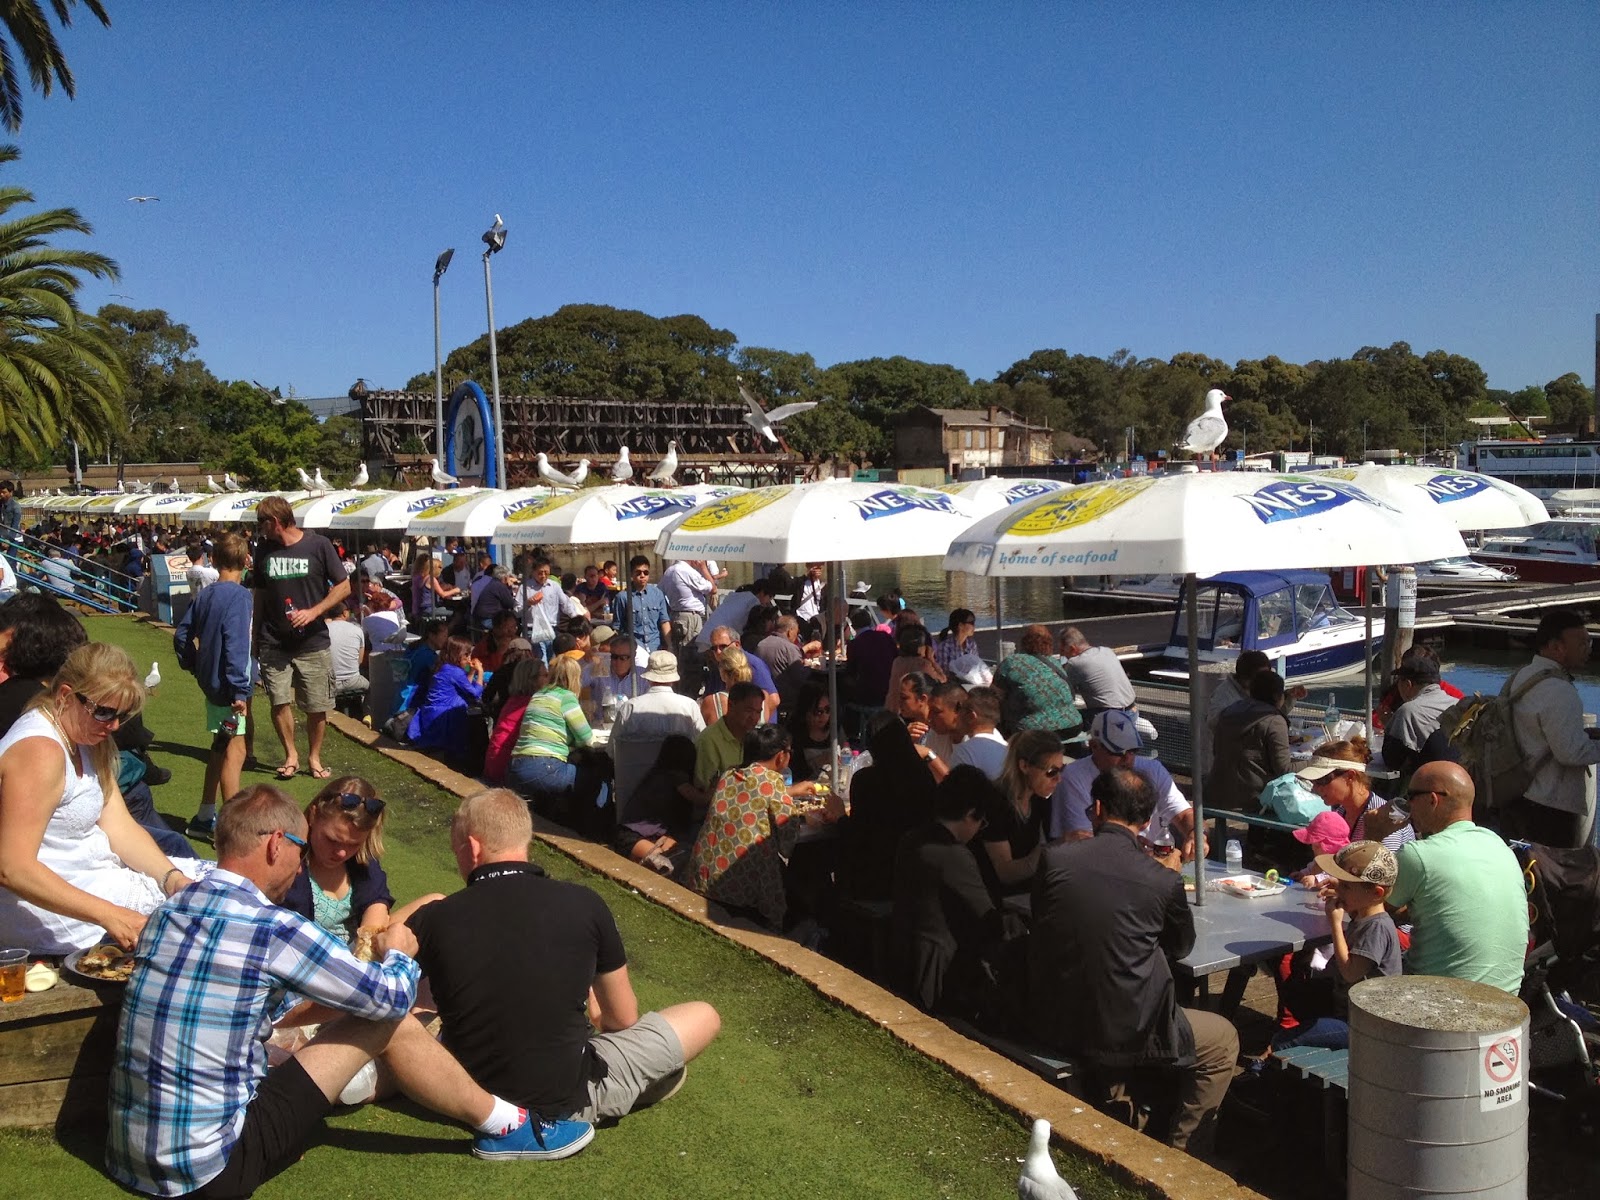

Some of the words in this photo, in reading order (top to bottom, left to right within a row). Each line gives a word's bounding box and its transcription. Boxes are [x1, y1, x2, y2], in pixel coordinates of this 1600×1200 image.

[669, 542, 695, 553] home
[697, 543, 707, 554] of
[708, 543, 747, 554] seafood
[1000, 552, 1037, 565] home
[1041, 551, 1057, 566] of
[1059, 549, 1119, 566] seafood
[268, 556, 309, 578] NIKE
[1484, 1089, 1495, 1098] NO
[1496, 1081, 1521, 1095] SMOKING
[1497, 1094, 1513, 1104] AREA
